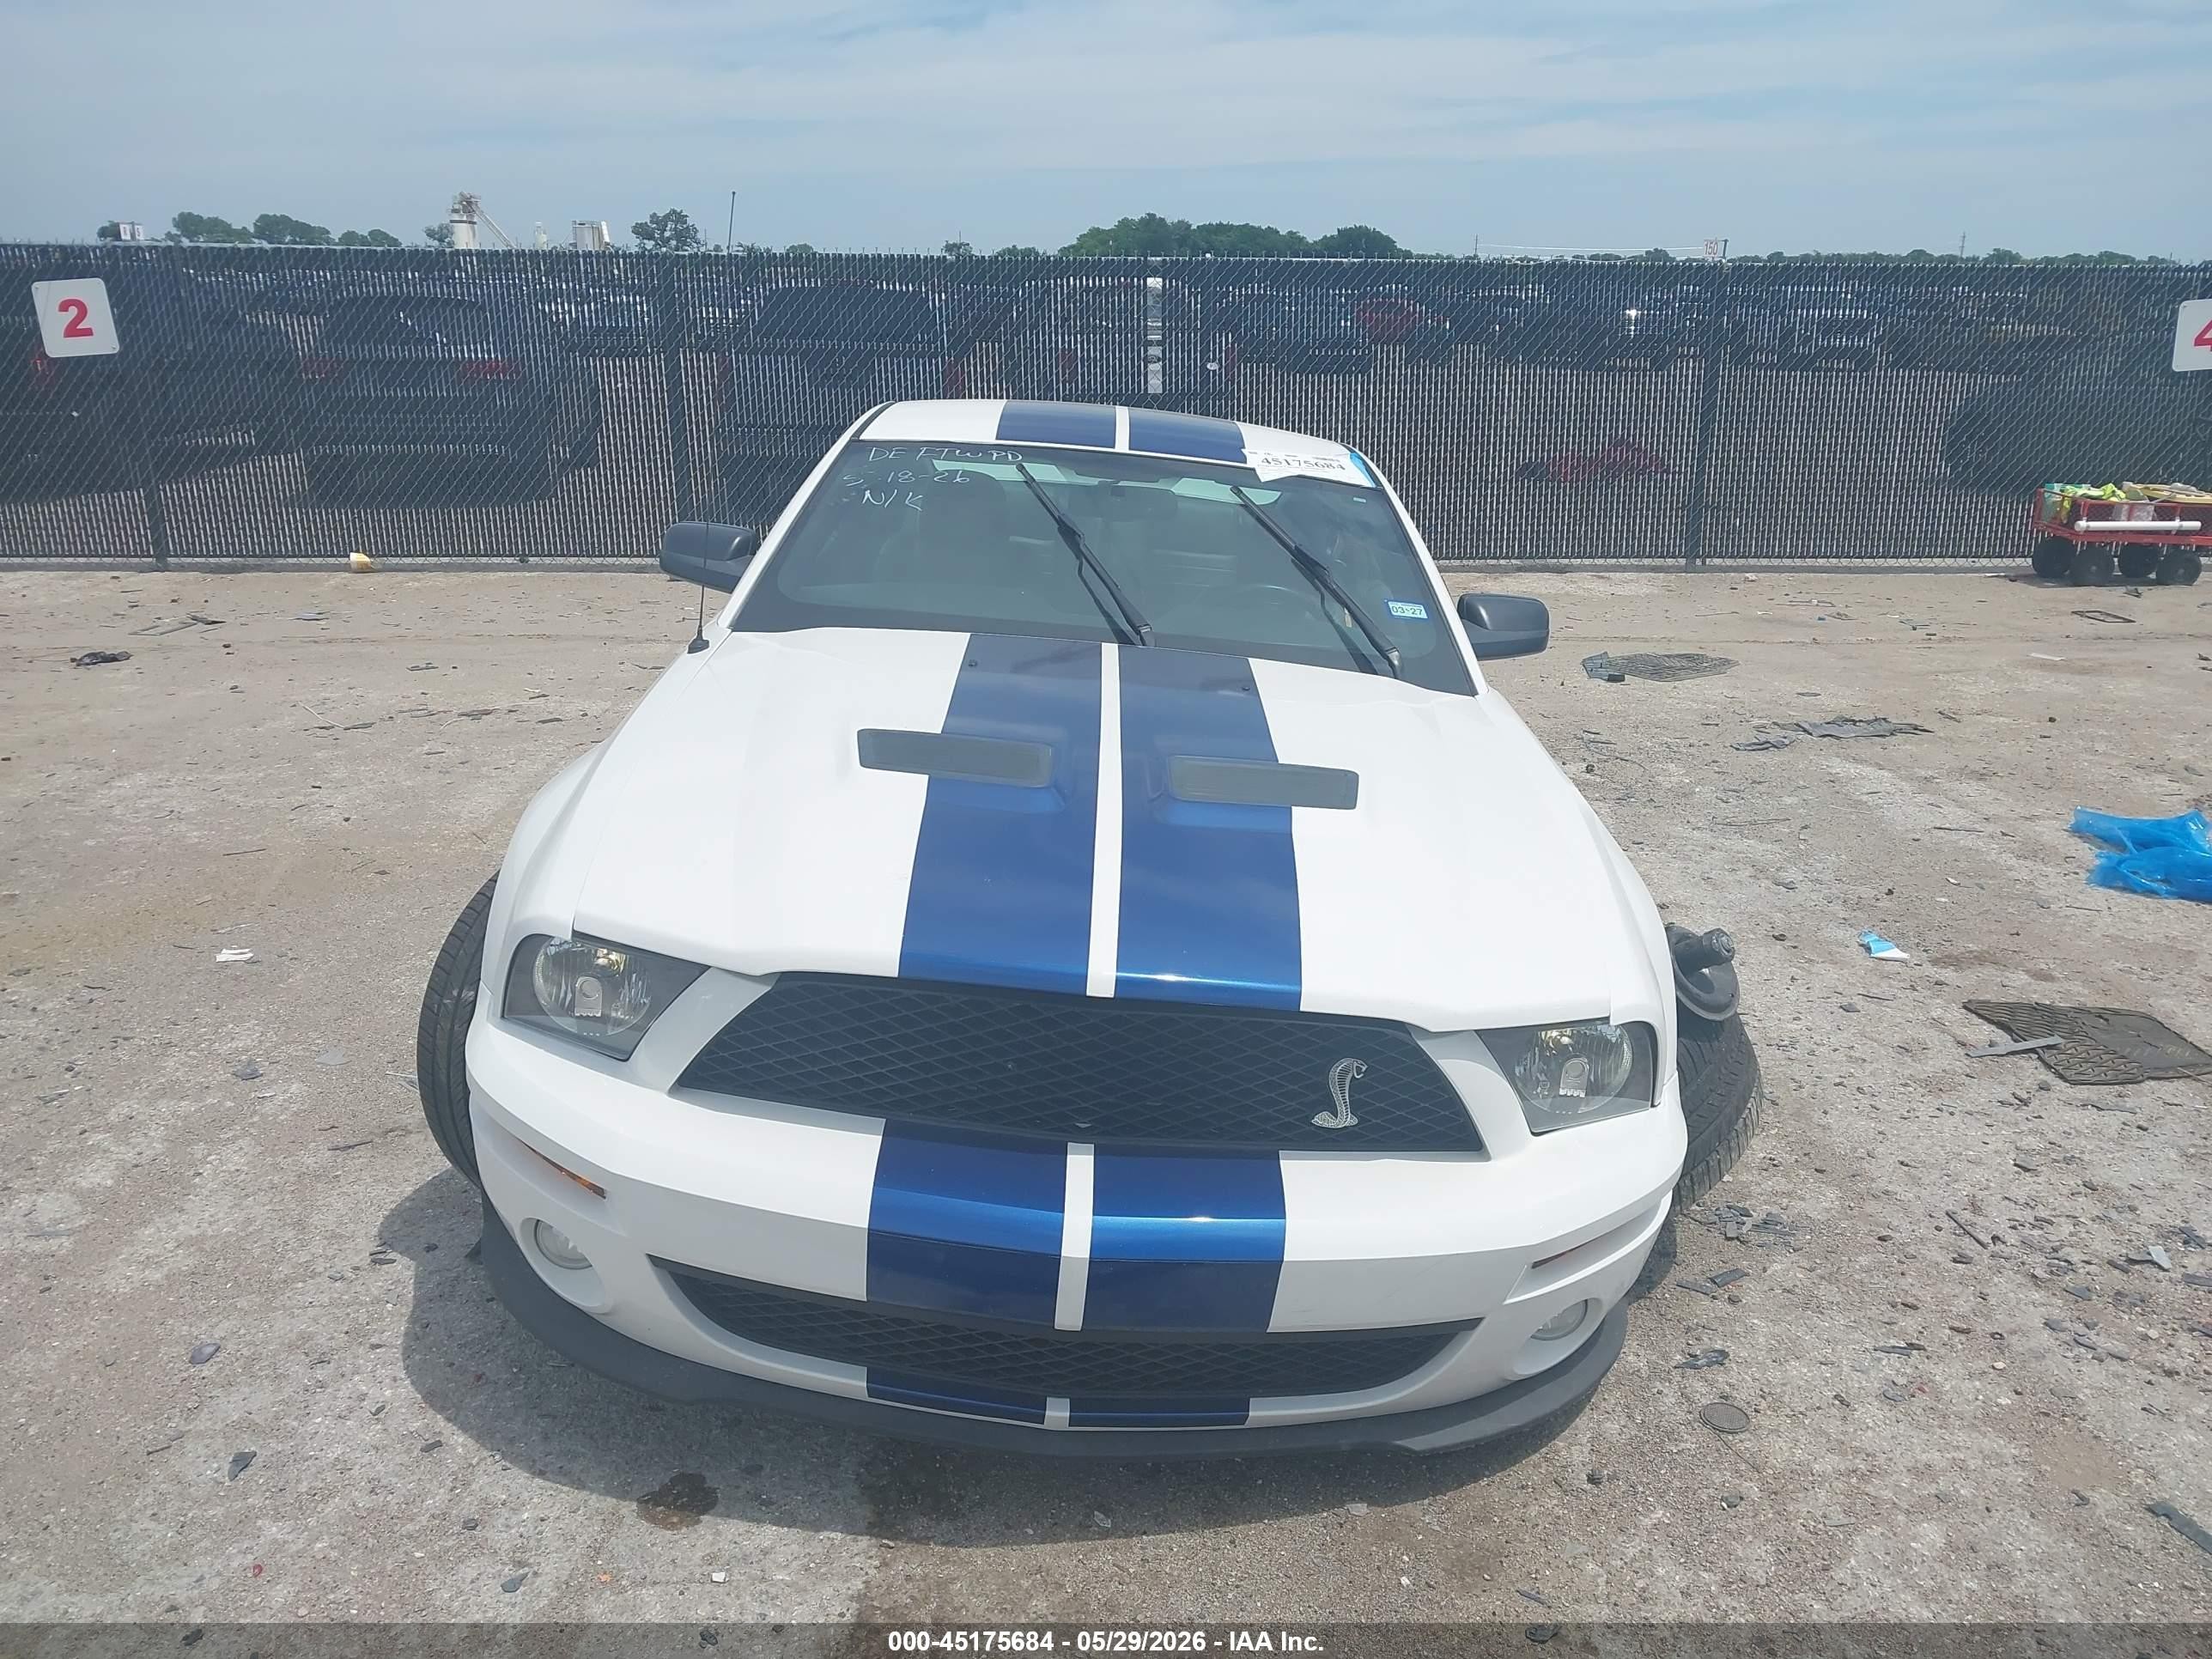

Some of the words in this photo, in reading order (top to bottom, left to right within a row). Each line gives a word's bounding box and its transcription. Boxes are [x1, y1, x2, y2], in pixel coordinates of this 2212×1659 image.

[1705, 241, 1718, 255] 150
[58, 298, 94, 338] 2
[866, 447, 908, 461] DE
[1261, 457, 1346, 471] 45175684
